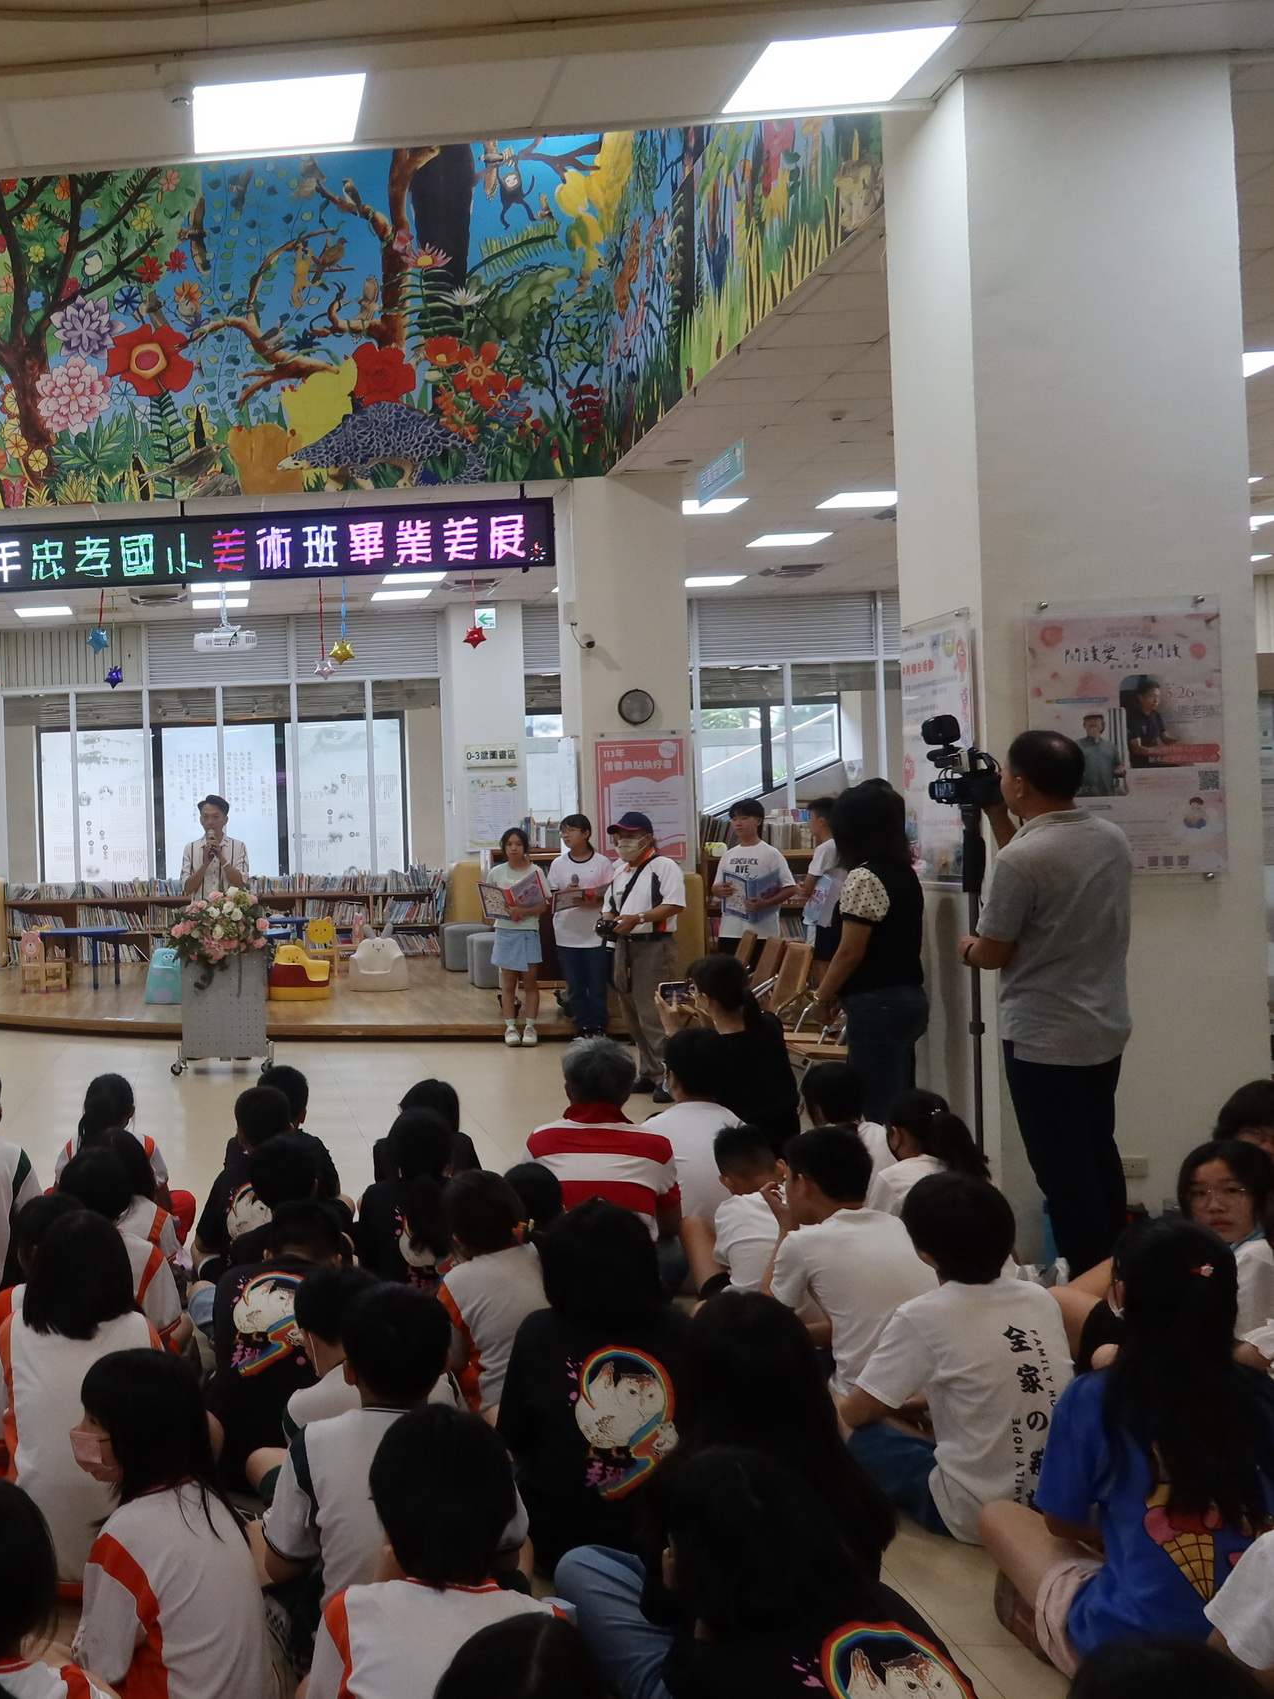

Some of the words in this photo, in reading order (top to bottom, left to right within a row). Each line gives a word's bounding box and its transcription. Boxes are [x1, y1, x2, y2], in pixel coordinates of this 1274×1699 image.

[735, 865, 749, 873] AVE
[1030, 1329, 1054, 1383] FAMILY
[1012, 1417, 1023, 1454] HOPE
